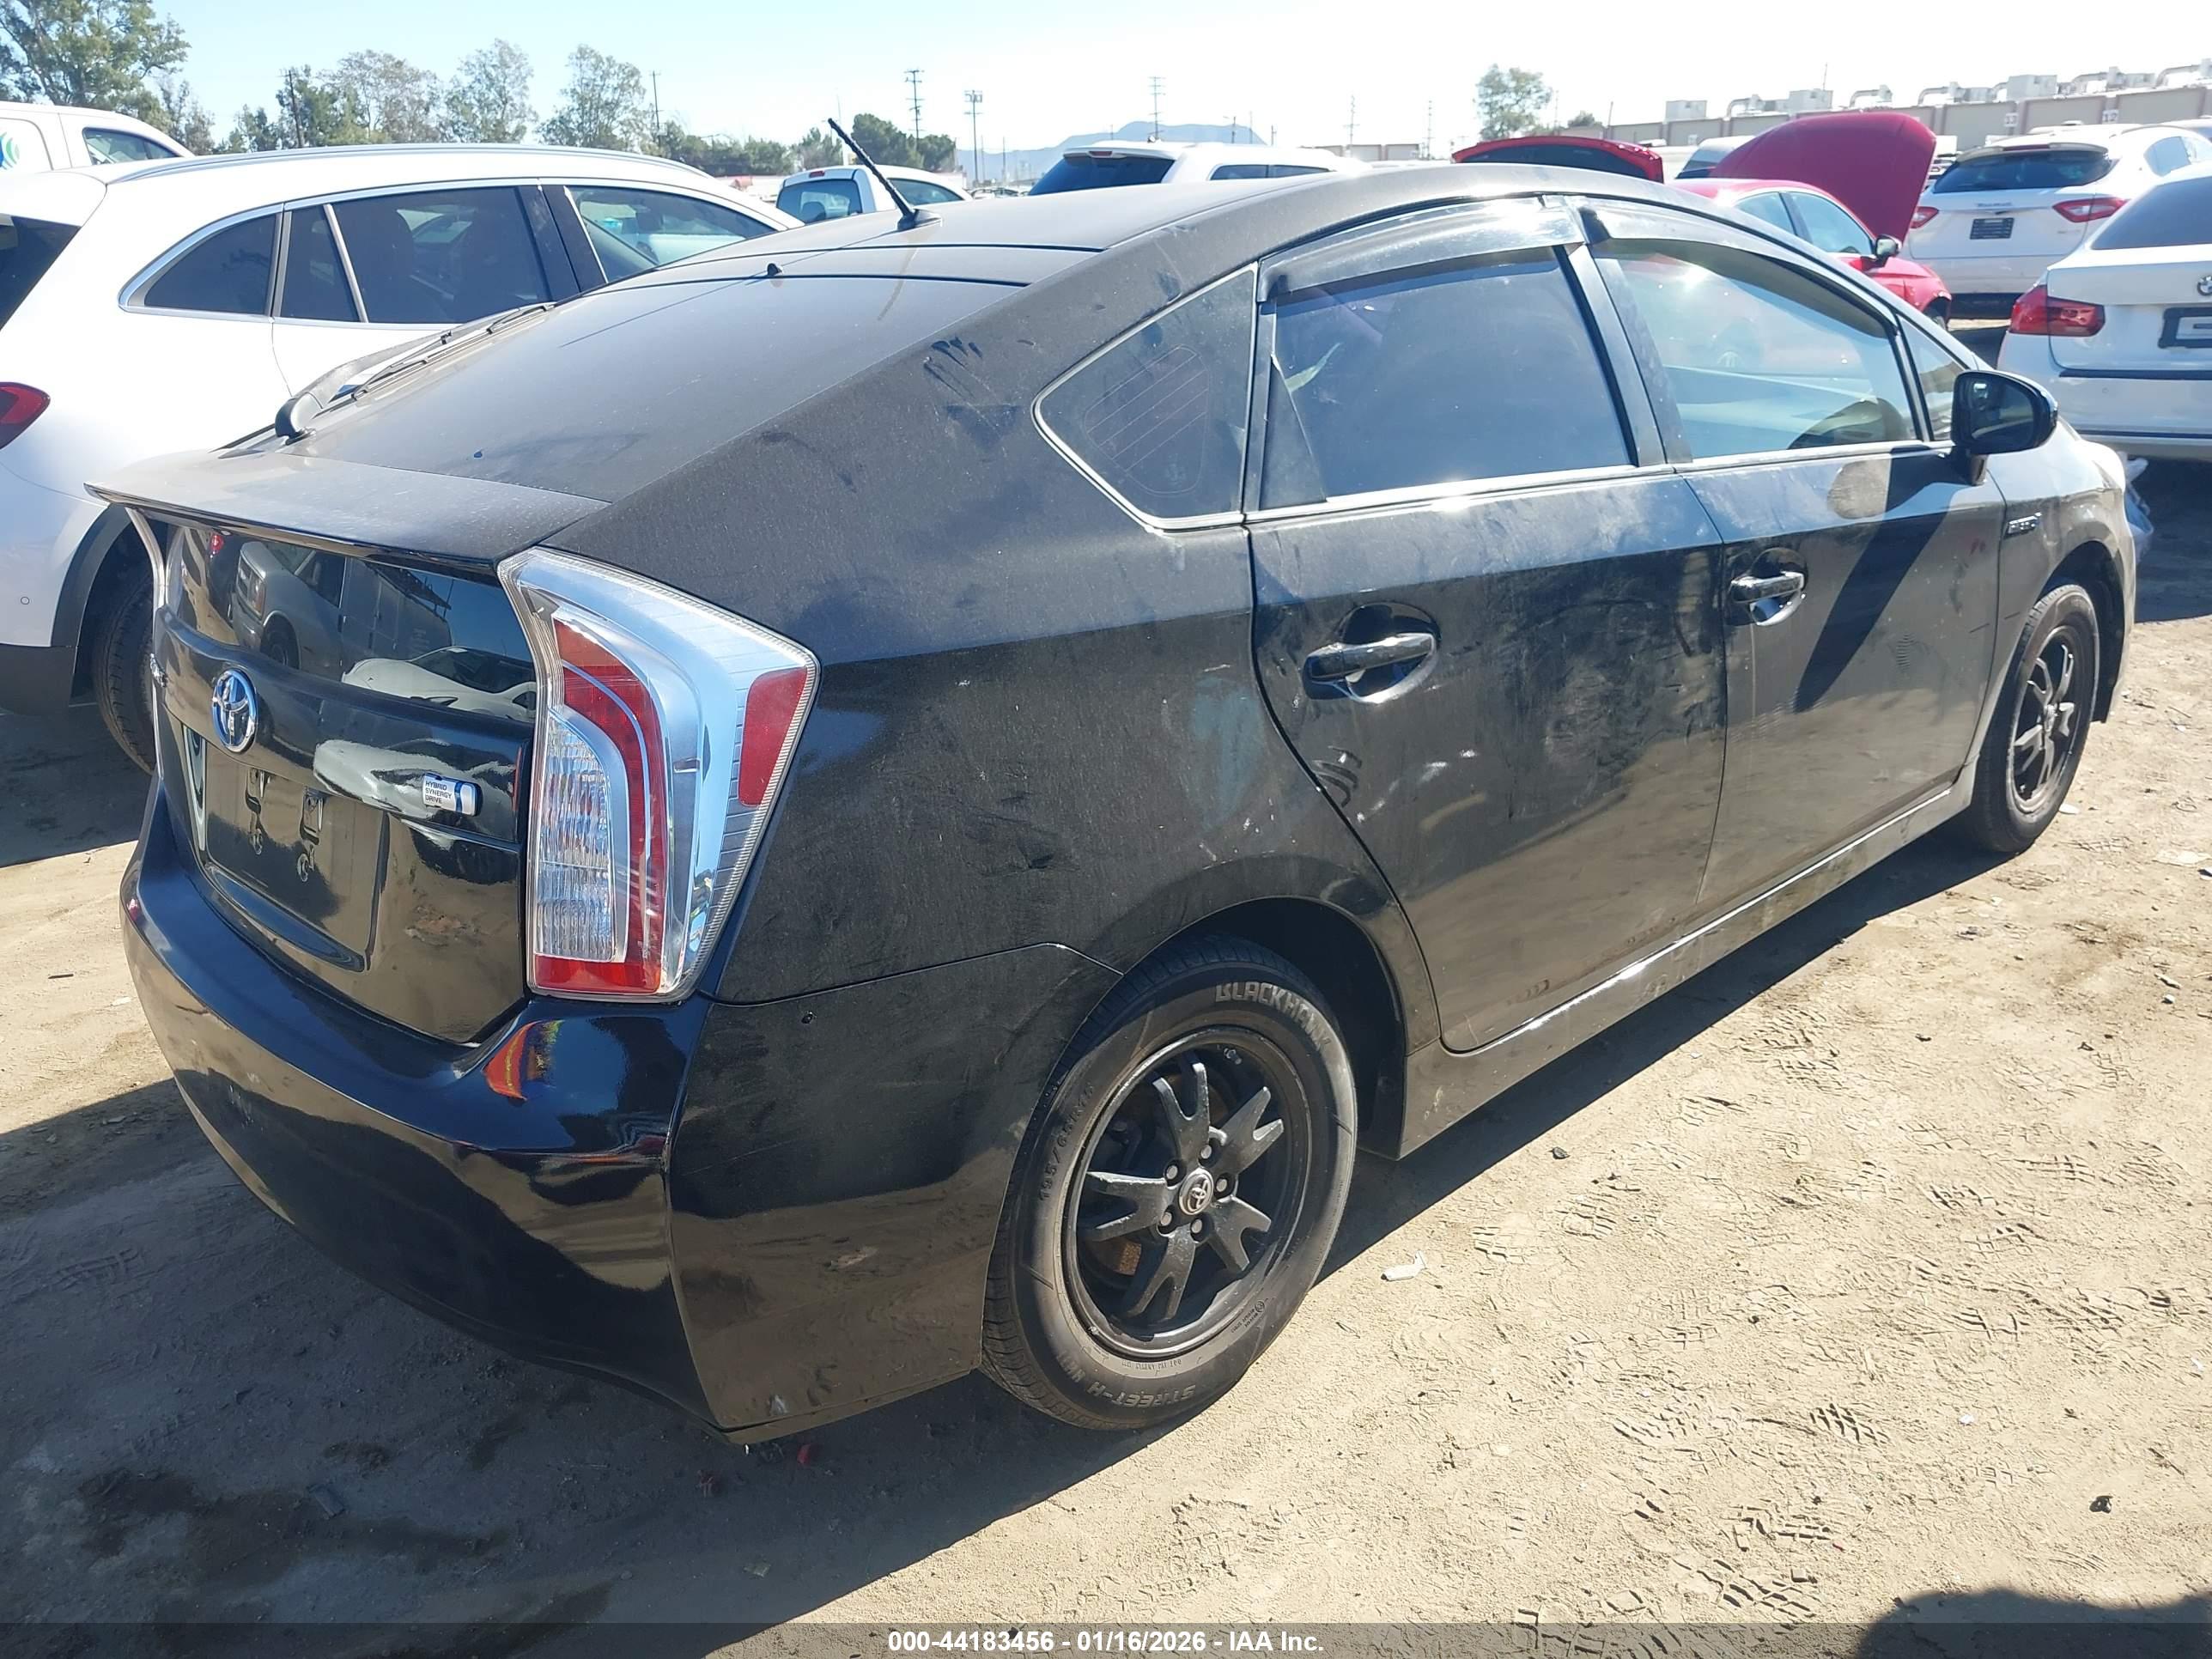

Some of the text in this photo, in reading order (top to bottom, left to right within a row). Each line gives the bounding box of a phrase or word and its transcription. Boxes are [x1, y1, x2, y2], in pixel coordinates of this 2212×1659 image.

[425, 780, 447, 791] HYBRID
[425, 787, 453, 799] SYNERGY
[425, 794, 443, 804] DRIVE
[1087, 1382, 1195, 1408] STREET-H
